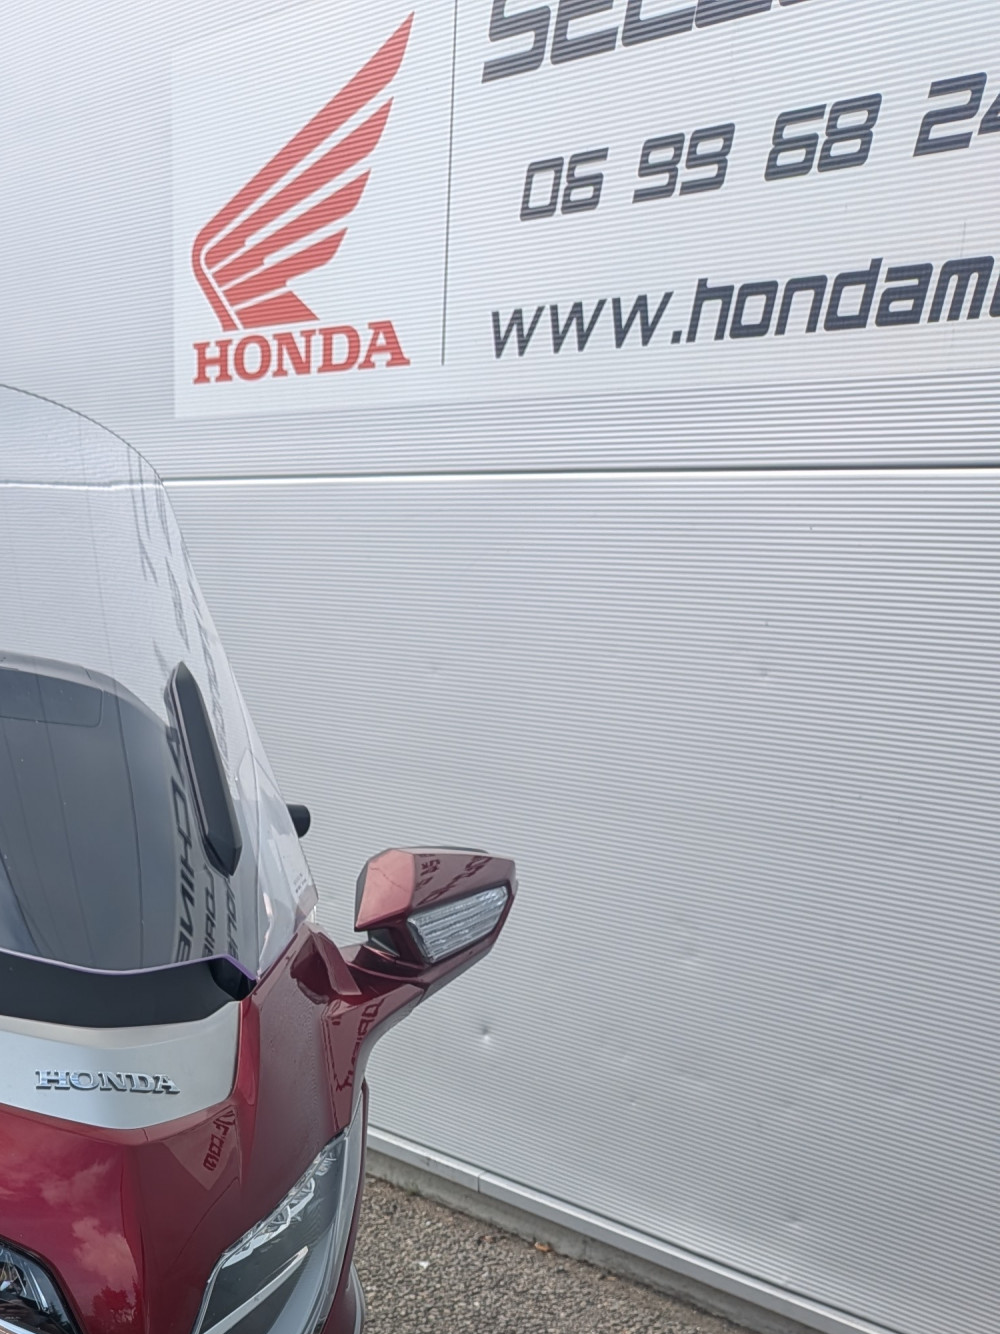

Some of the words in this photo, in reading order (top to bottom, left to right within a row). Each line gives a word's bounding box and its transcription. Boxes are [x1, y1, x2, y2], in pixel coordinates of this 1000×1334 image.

[519, 147, 609, 222] 06
[632, 122, 736, 204] 99
[764, 93, 882, 181] 68
[491, 255, 1000, 359] www.hondam
[192, 320, 411, 385] HONDA
[34, 1069, 181, 1095] HONDA
